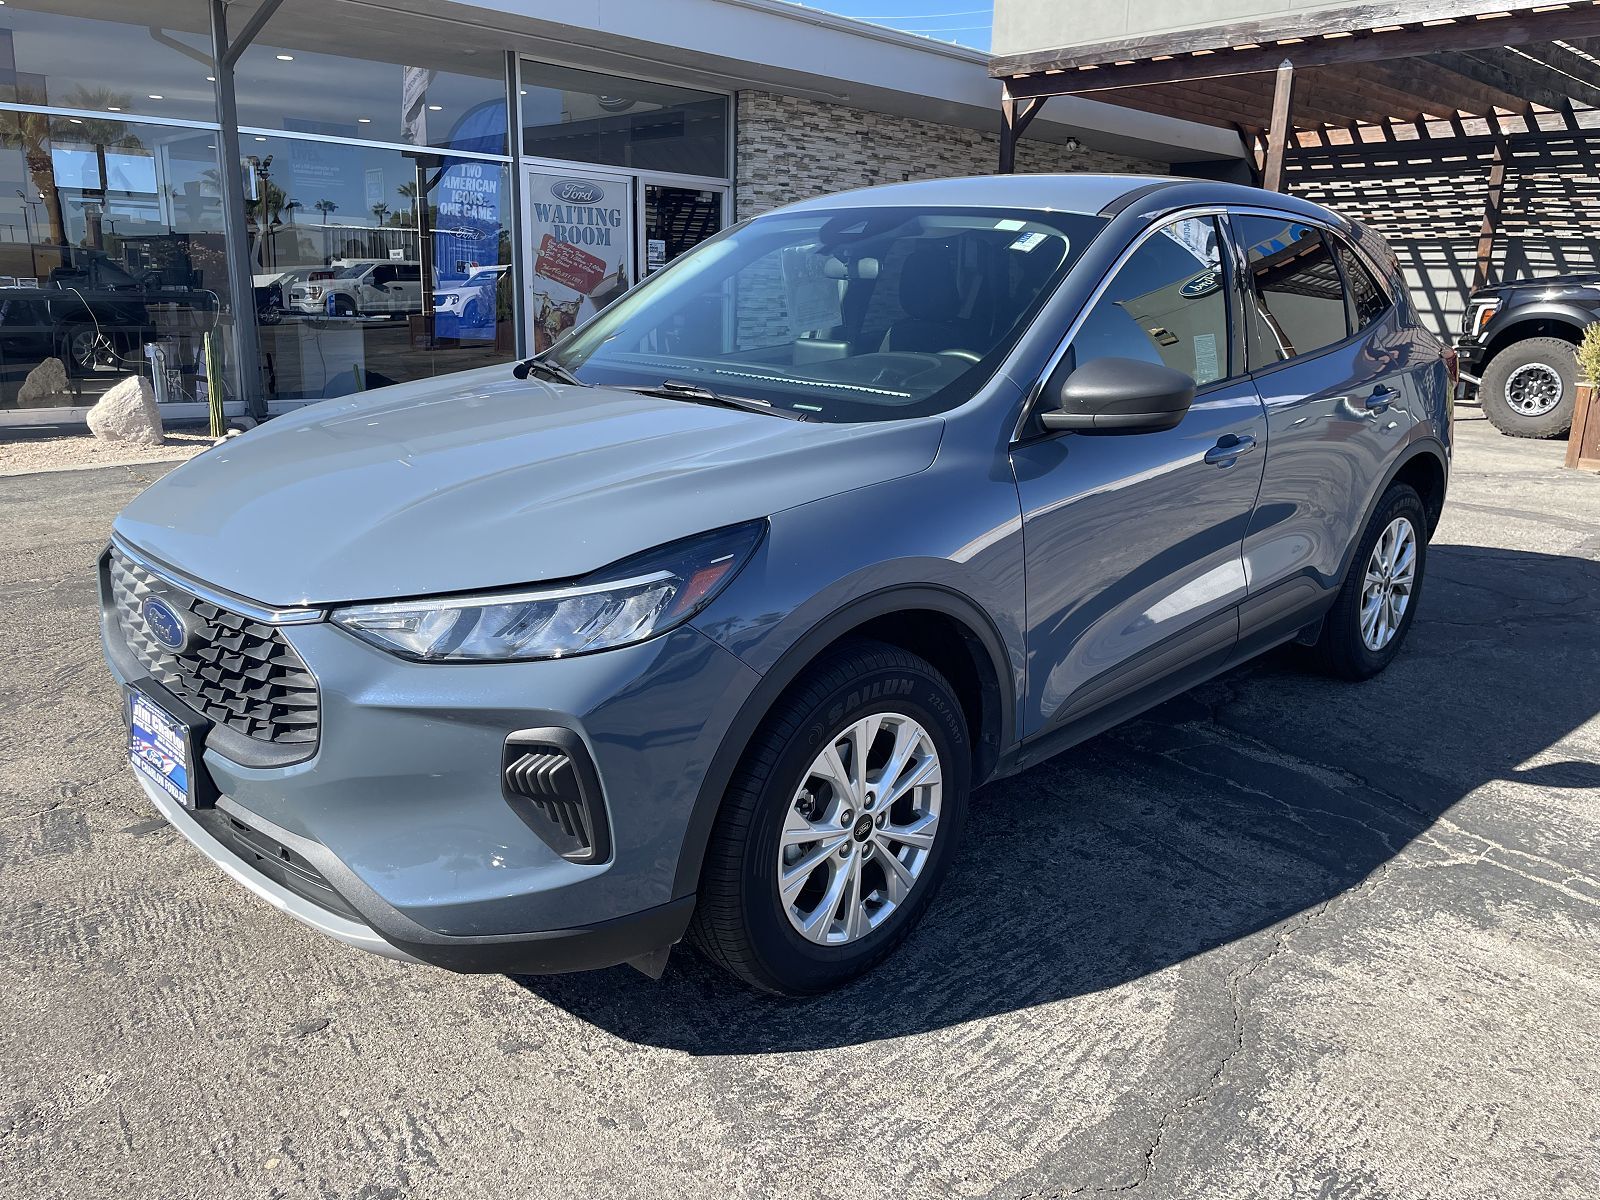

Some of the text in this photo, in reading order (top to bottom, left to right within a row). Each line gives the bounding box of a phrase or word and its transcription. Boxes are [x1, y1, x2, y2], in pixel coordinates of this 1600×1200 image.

[461, 164, 482, 178] TWO
[443, 176, 497, 194] AMERICAN
[562, 183, 593, 201] Ford
[451, 190, 487, 205] ICONS.
[440, 202, 497, 221] ONE GAME.
[534, 202, 621, 228] WAITING
[554, 225, 611, 246] ROOM
[149, 607, 172, 642] Ford
[132, 703, 151, 726] Jim
[829, 679, 964, 744] SAILUN 225/65R17
